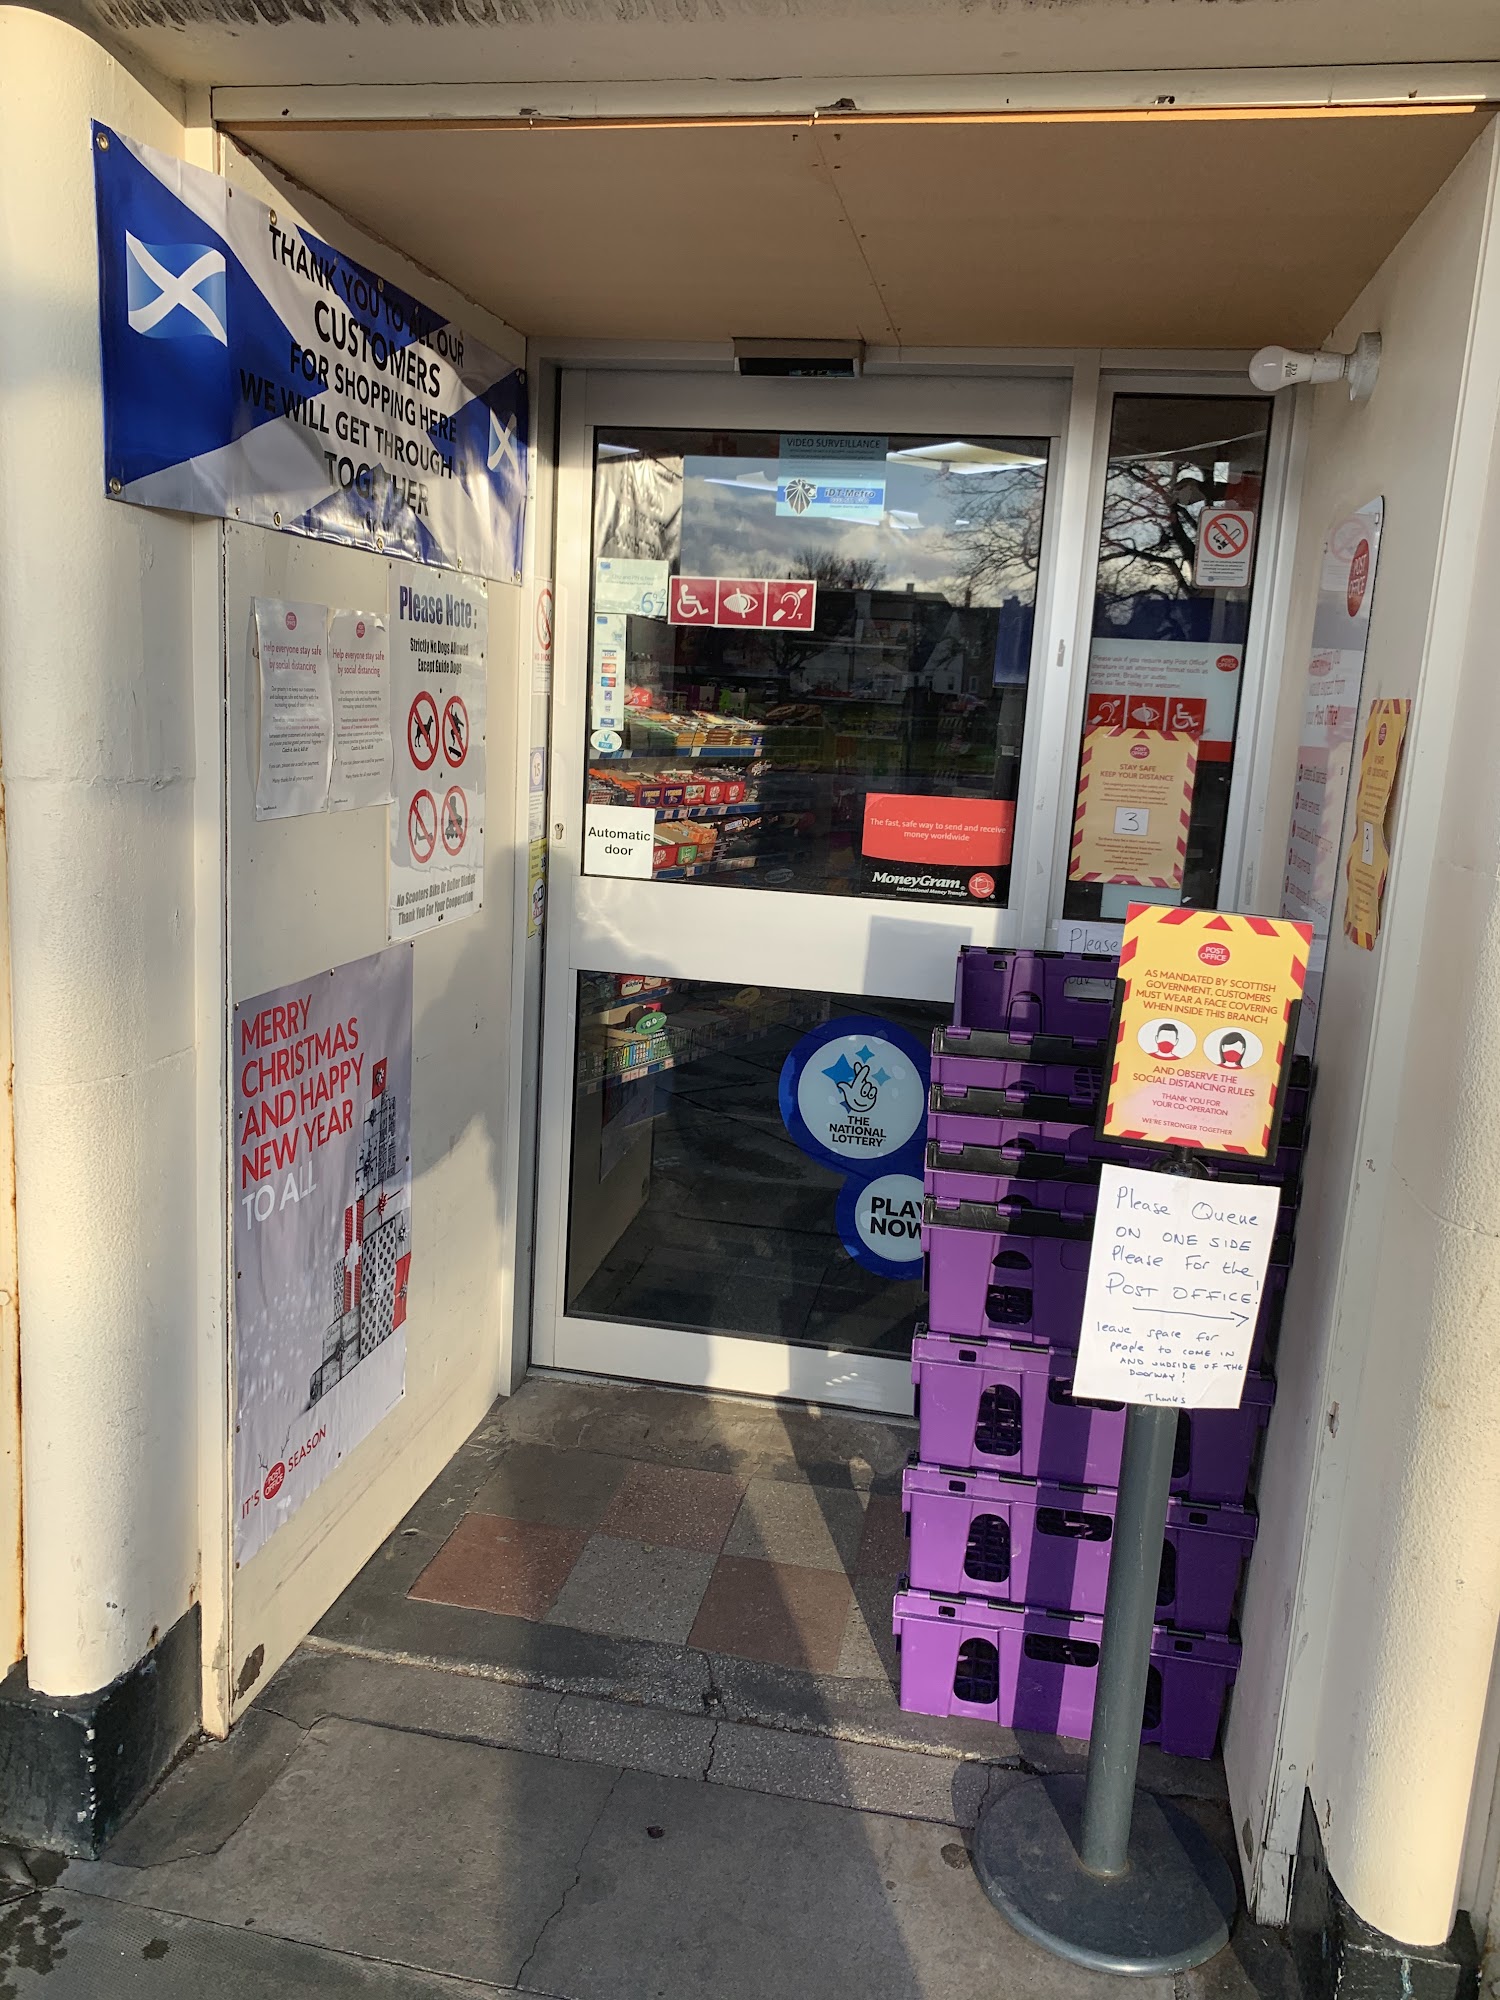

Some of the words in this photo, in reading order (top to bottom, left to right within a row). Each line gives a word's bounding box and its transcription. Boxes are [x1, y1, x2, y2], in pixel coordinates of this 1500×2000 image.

[269, 225, 338, 294] THANK
[341, 270, 379, 317] YOU
[382, 297, 403, 332] TO
[409, 311, 432, 347] ALL
[437, 330, 463, 368] OUR
[315, 300, 440, 398] CUSTOMERS
[291, 341, 329, 385] FOR
[334, 363, 416, 426] SHOPPING
[419, 404, 457, 443] HERE
[239, 369, 276, 413] WE
[281, 387, 329, 434] WILL
[336, 411, 369, 447] GET
[374, 426, 452, 479] THROUGH
[787, 439, 813, 447] VIDEO
[816, 439, 880, 448] SURVEILLANCE
[324, 451, 429, 516] TOGHER
[1353, 554, 1367, 577] POST
[1349, 575, 1365, 598] OFFICE
[400, 585, 443, 624] Please
[333, 648, 344, 662] Help
[345, 652, 364, 662] everyone
[366, 652, 374, 662] stay
[375, 651, 384, 661] safe
[410, 638, 429, 654] Strictly
[430, 640, 436, 653] No
[438, 641, 449, 655] Dogs
[451, 642, 468, 655] Allowed
[338, 664, 343, 676] by
[344, 665, 356, 674] social
[358, 665, 380, 677] distancing
[418, 658, 434, 673] Except
[436, 660, 449, 673] Guide
[450, 661, 461, 675] Dogs
[1122, 812, 1139, 831] 3
[588, 827, 651, 841] Automatic
[904, 832, 929, 840] money
[930, 833, 970, 841] worldwide
[604, 844, 633, 856] door
[872, 872, 961, 888] MoneyGram
[397, 894, 404, 907] No
[405, 888, 428, 905] Scooters
[399, 909, 415, 925] Thank
[416, 907, 425, 919] You
[435, 900, 445, 913] Your
[446, 891, 473, 909] Cooperation
[1069, 928, 1118, 952] Please
[1200, 953, 1227, 962] OFFICE
[1145, 969, 1158, 978] AS
[1159, 971, 1214, 985] MANDATED
[1215, 978, 1228, 987] BY
[1230, 979, 1276, 993] SCOTTISH
[1136, 990, 1162, 1000] MUST
[1163, 993, 1192, 1004] WEAR
[1195, 996, 1202, 1005] A
[1204, 998, 1227, 1008] FACE
[1228, 1001, 1277, 1015] COVERING
[1215, 989, 1271, 1003] CUSTOMERS
[1143, 1001, 1172, 1012] WHEN
[1174, 1005, 1203, 1016] INSIDE
[1205, 1009, 1225, 1019] THIS
[1227, 1012, 1268, 1024] BRANCH
[241, 994, 312, 1056] MERRY
[241, 1017, 359, 1098] CHRISTMAS
[1133, 1073, 1167, 1084] SOCIAL
[1169, 1077, 1226, 1093] DISTANCING
[1228, 1085, 1255, 1097] RULES
[1153, 1066, 1175, 1076] AND
[1177, 1069, 1219, 1082] OBSERVE
[1220, 1074, 1238, 1084] THE
[241, 1089, 296, 1146] AND
[300, 1052, 365, 1116] HAPPY
[1152, 1100, 1172, 1110] YOUR
[1173, 1102, 1228, 1116] CO-OPERATION
[1162, 1093, 1188, 1103] THANK
[1189, 1096, 1206, 1104] YOU
[1206, 1098, 1221, 1106] FOR
[829, 1123, 887, 1138] NATIONAL
[847, 1116, 870, 1126] THE
[1142, 1117, 1161, 1125] WE'RE
[1163, 1120, 1197, 1131] STRONGER
[1199, 1125, 1232, 1135] TOGETHER
[242, 1127, 299, 1190] NEW
[303, 1099, 353, 1153] YEAR
[832, 1133, 883, 1148] LOTTERY
[241, 1184, 275, 1231] TO
[279, 1160, 317, 1211] ALL
[1117, 1185, 1171, 1215] Please
[1192, 1201, 1259, 1226] Queue
[870, 1217, 922, 1239] NOW
[1116, 1226, 1141, 1238] ON
[1163, 1232, 1198, 1246] ONE
[1209, 1237, 1252, 1251] SIDE
[1112, 1245, 1164, 1267] Please
[1223, 1262, 1254, 1277] the
[1098, 1322, 1132, 1334] leave
[1196, 1332, 1219, 1341] for
[1110, 1341, 1144, 1352] people
[1158, 1346, 1172, 1354] to
[1145, 1394, 1186, 1404] Thanks
[242, 1490, 260, 1519] IT'S
[288, 1424, 326, 1472] SEASON
[267, 1466, 282, 1484] POST
[265, 1475, 284, 1495] OFFICE
